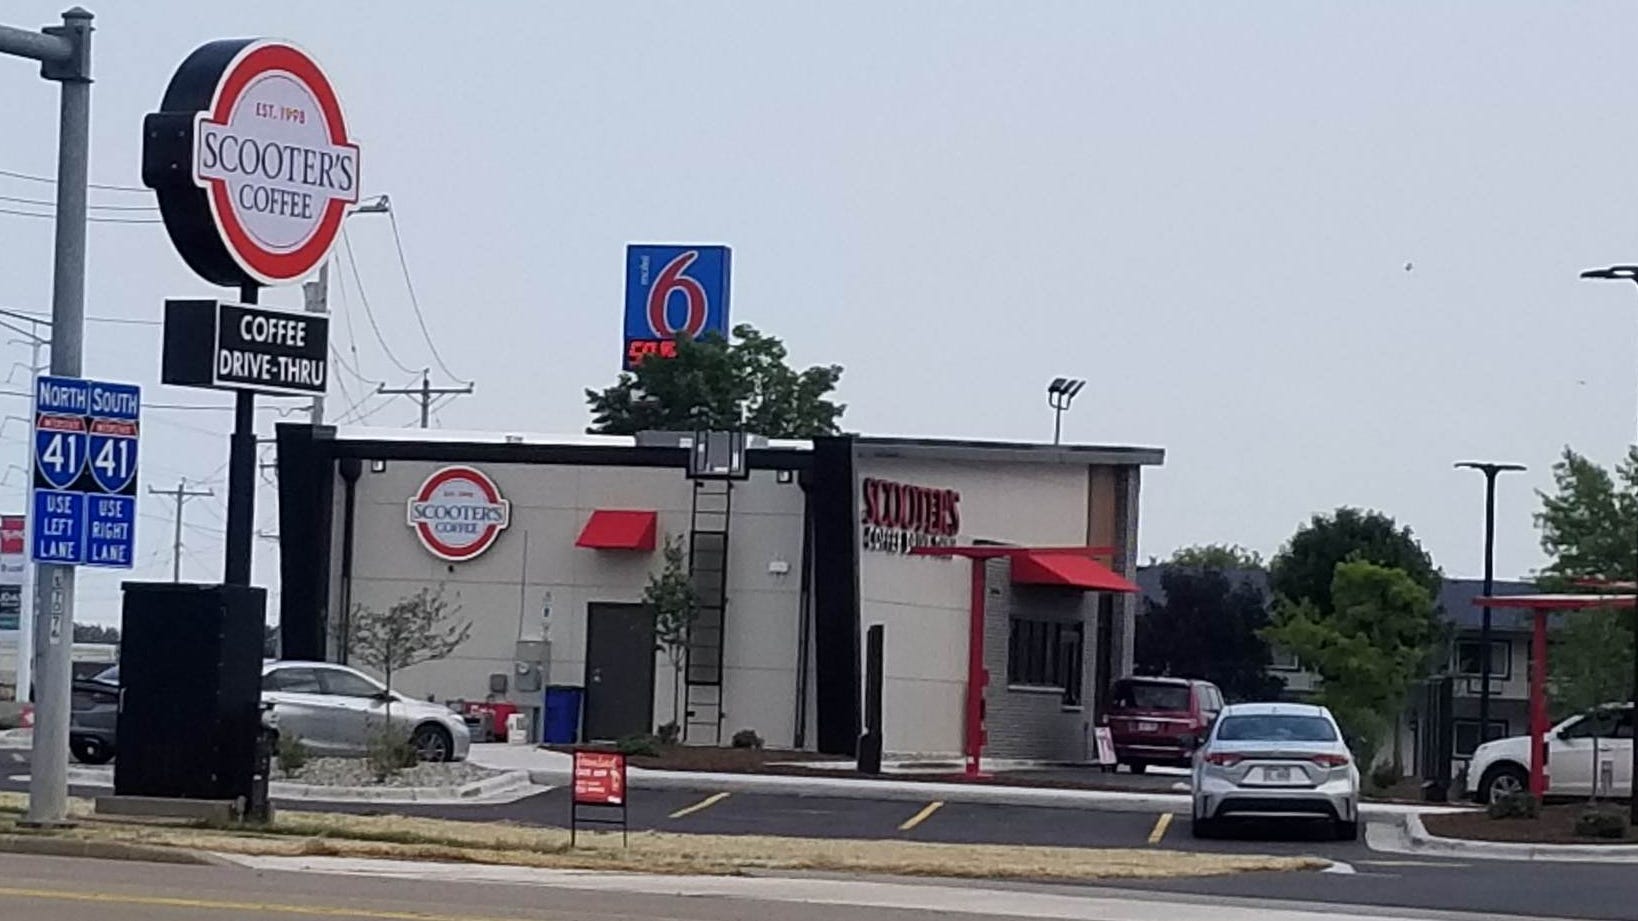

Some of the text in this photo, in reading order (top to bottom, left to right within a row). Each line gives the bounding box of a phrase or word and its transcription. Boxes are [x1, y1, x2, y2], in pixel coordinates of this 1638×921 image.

[256, 102, 277, 119] EST.
[203, 131, 353, 191] SCOOTER'S
[239, 184, 313, 219] COFFEE
[646, 250, 708, 339] 6
[240, 314, 307, 347] COFFEE
[219, 348, 325, 386] DRIVE-THRU
[39, 381, 87, 410] NORTH
[92, 387, 138, 416] SOUTH
[42, 433, 76, 474] 41
[94, 438, 129, 479] 41
[46, 495, 73, 514] USE
[98, 499, 123, 519] USE
[43, 517, 74, 537] LEFT
[92, 521, 129, 540] RIGHT
[40, 539, 76, 559] LANE
[92, 543, 127, 562] LANE
